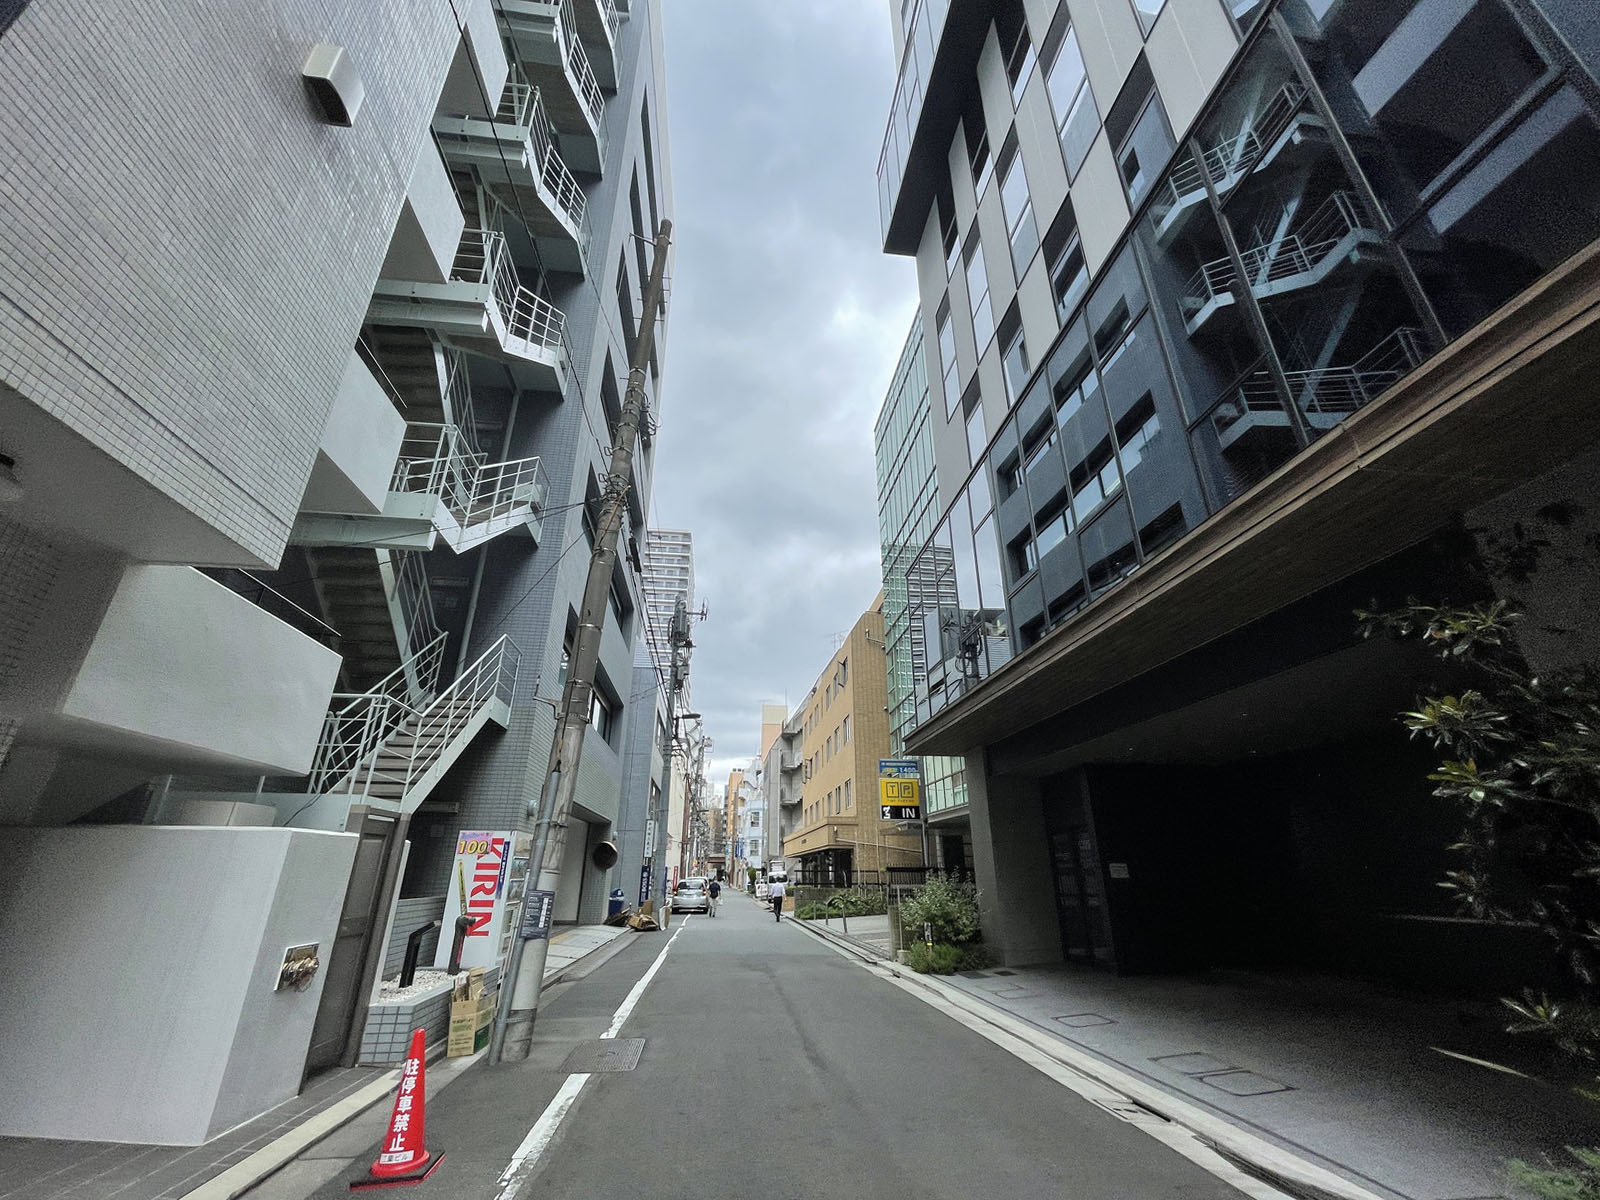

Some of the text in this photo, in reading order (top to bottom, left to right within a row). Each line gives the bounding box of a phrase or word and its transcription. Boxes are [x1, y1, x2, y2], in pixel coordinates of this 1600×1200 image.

[902, 808, 915, 818] IN
[465, 837, 504, 937] KIRIN
[389, 1058, 420, 1152] 駐停車禁止
